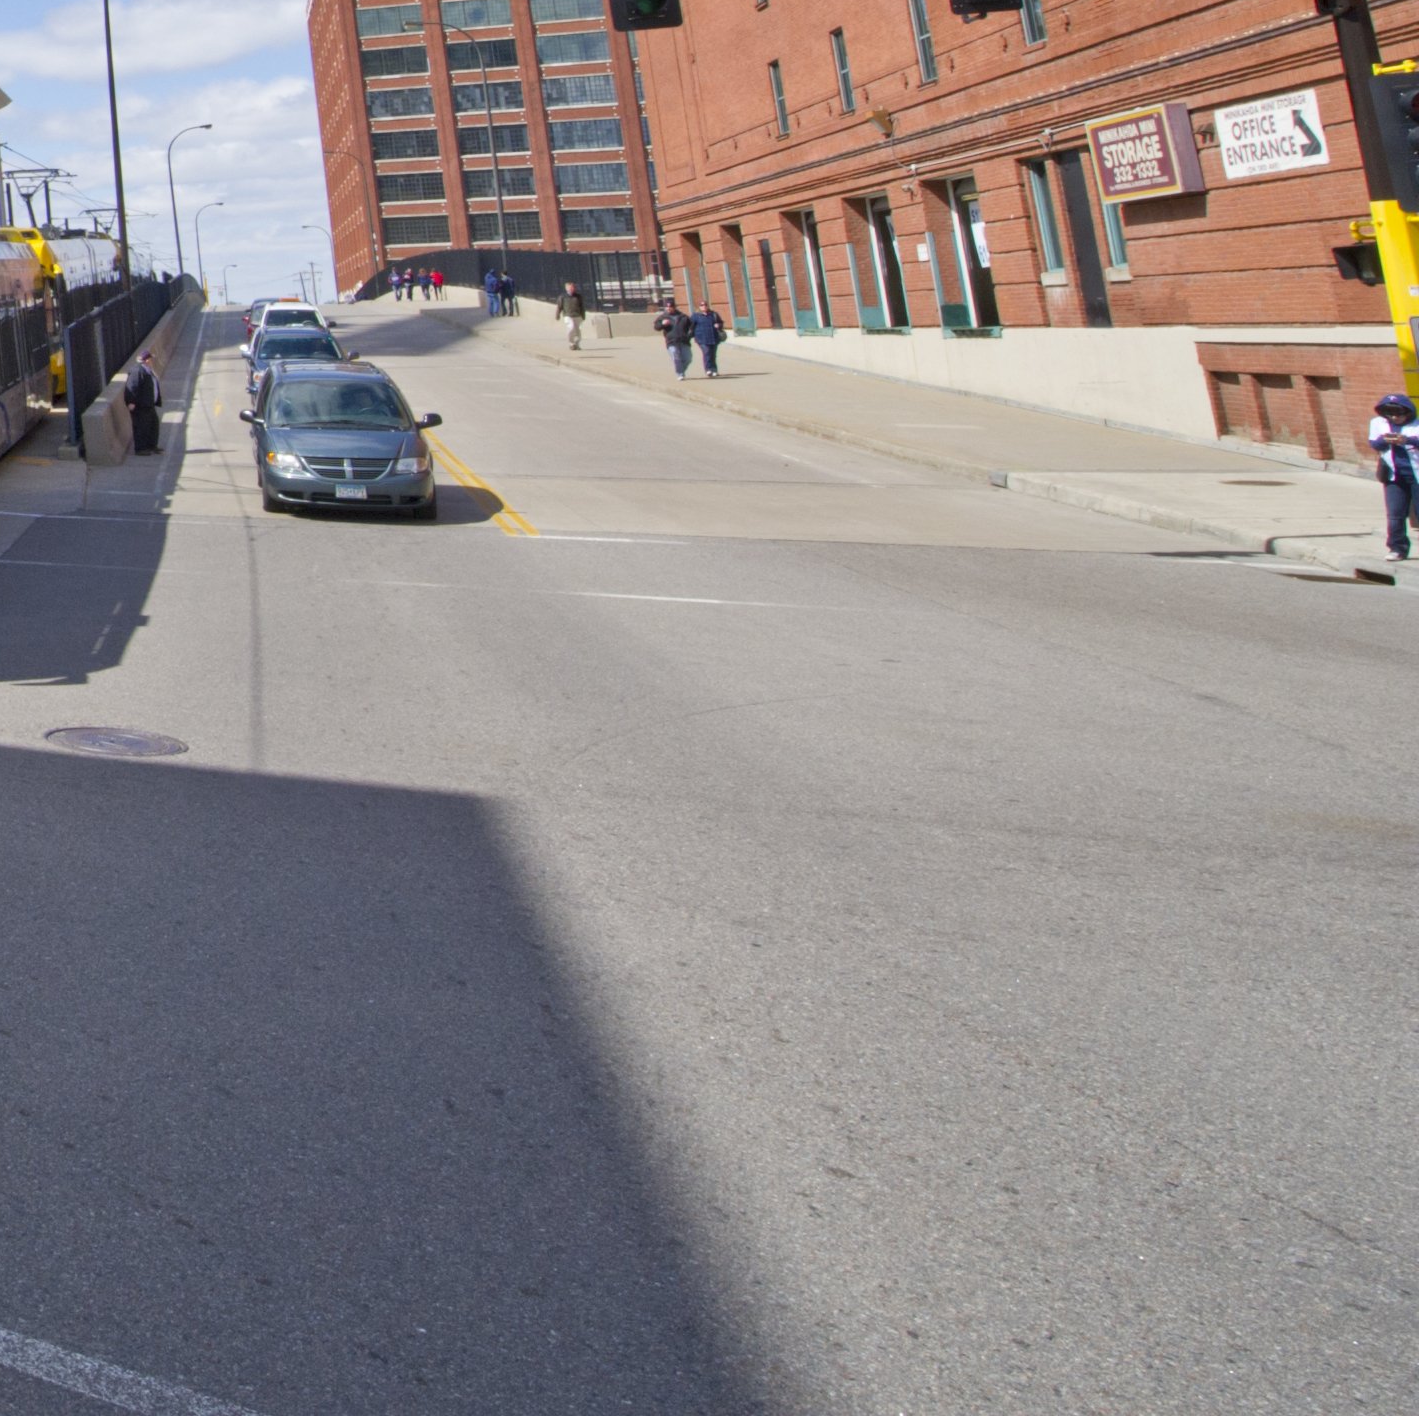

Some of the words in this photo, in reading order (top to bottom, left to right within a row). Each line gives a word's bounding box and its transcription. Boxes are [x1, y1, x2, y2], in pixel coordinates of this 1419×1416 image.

[1231, 115, 1276, 141] OFFICE
[1102, 135, 1163, 168] STORAGE
[1226, 135, 1297, 166] ENTRANCE
[1114, 160, 1161, 183] 332-1332
